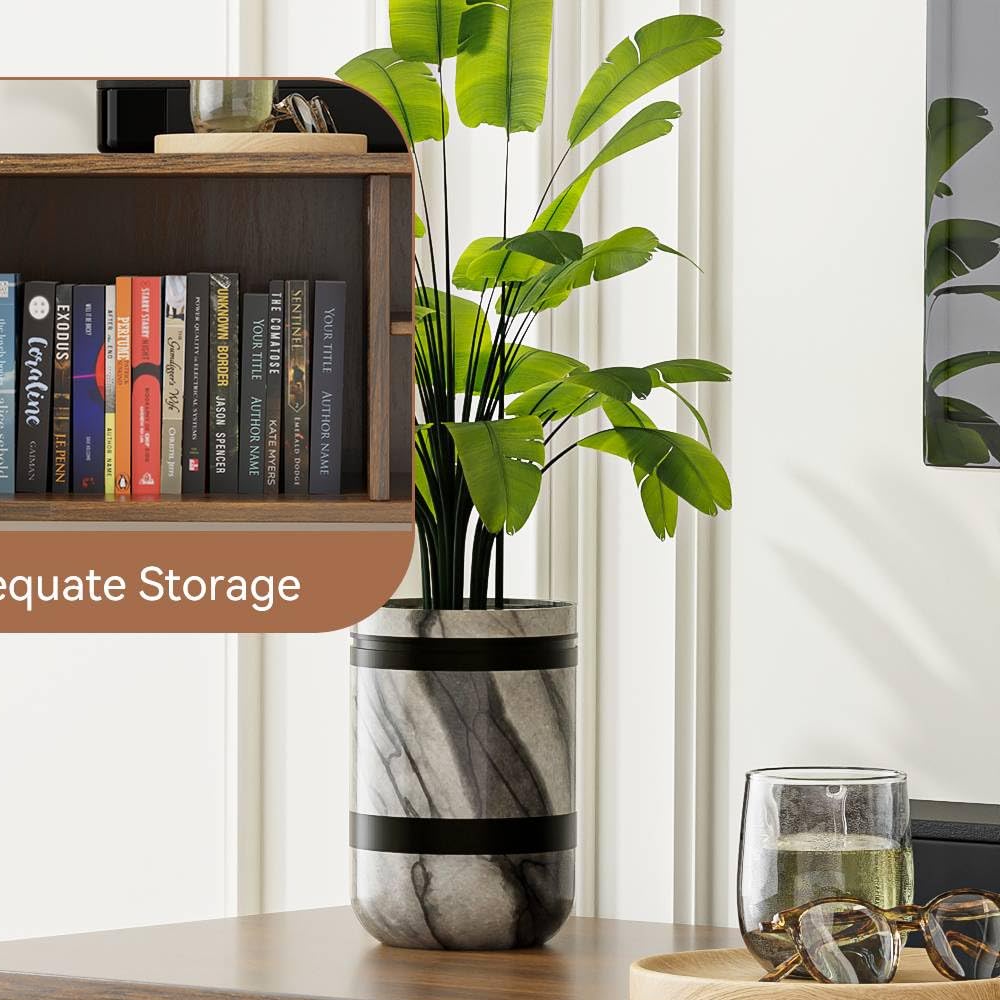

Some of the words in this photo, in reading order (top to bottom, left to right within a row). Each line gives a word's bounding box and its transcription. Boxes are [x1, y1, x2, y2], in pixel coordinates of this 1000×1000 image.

[217, 288, 229, 340] UNKNOWN
[271, 292, 282, 312] THE
[56, 304, 70, 361] EXODUS
[252, 319, 265, 350] YOUR
[291, 289, 303, 352] SENTINEL
[323, 307, 335, 340] YOUR
[117, 316, 130, 361] PERFUME
[269, 318, 281, 375] COMATOSE
[217, 346, 229, 387] BORDER
[251, 352, 263, 381] TITLE
[322, 343, 333, 373] TITLE
[24, 336, 49, 427] Coraline
[165, 388, 180, 413] Wife
[215, 396, 226, 425] JASON
[321, 390, 333, 439] AUTHOR
[191, 408, 199, 441] SYSTEMS
[249, 396, 263, 442] AUTHOR
[268, 419, 277, 447] KATE
[28, 440, 37, 481] GAIMAN
[55, 450, 66, 484] PENN
[215, 432, 226, 474] SPENCER
[248, 445, 261, 477] NAME
[267, 449, 277, 486] MYERS
[319, 443, 330, 476] NAME
